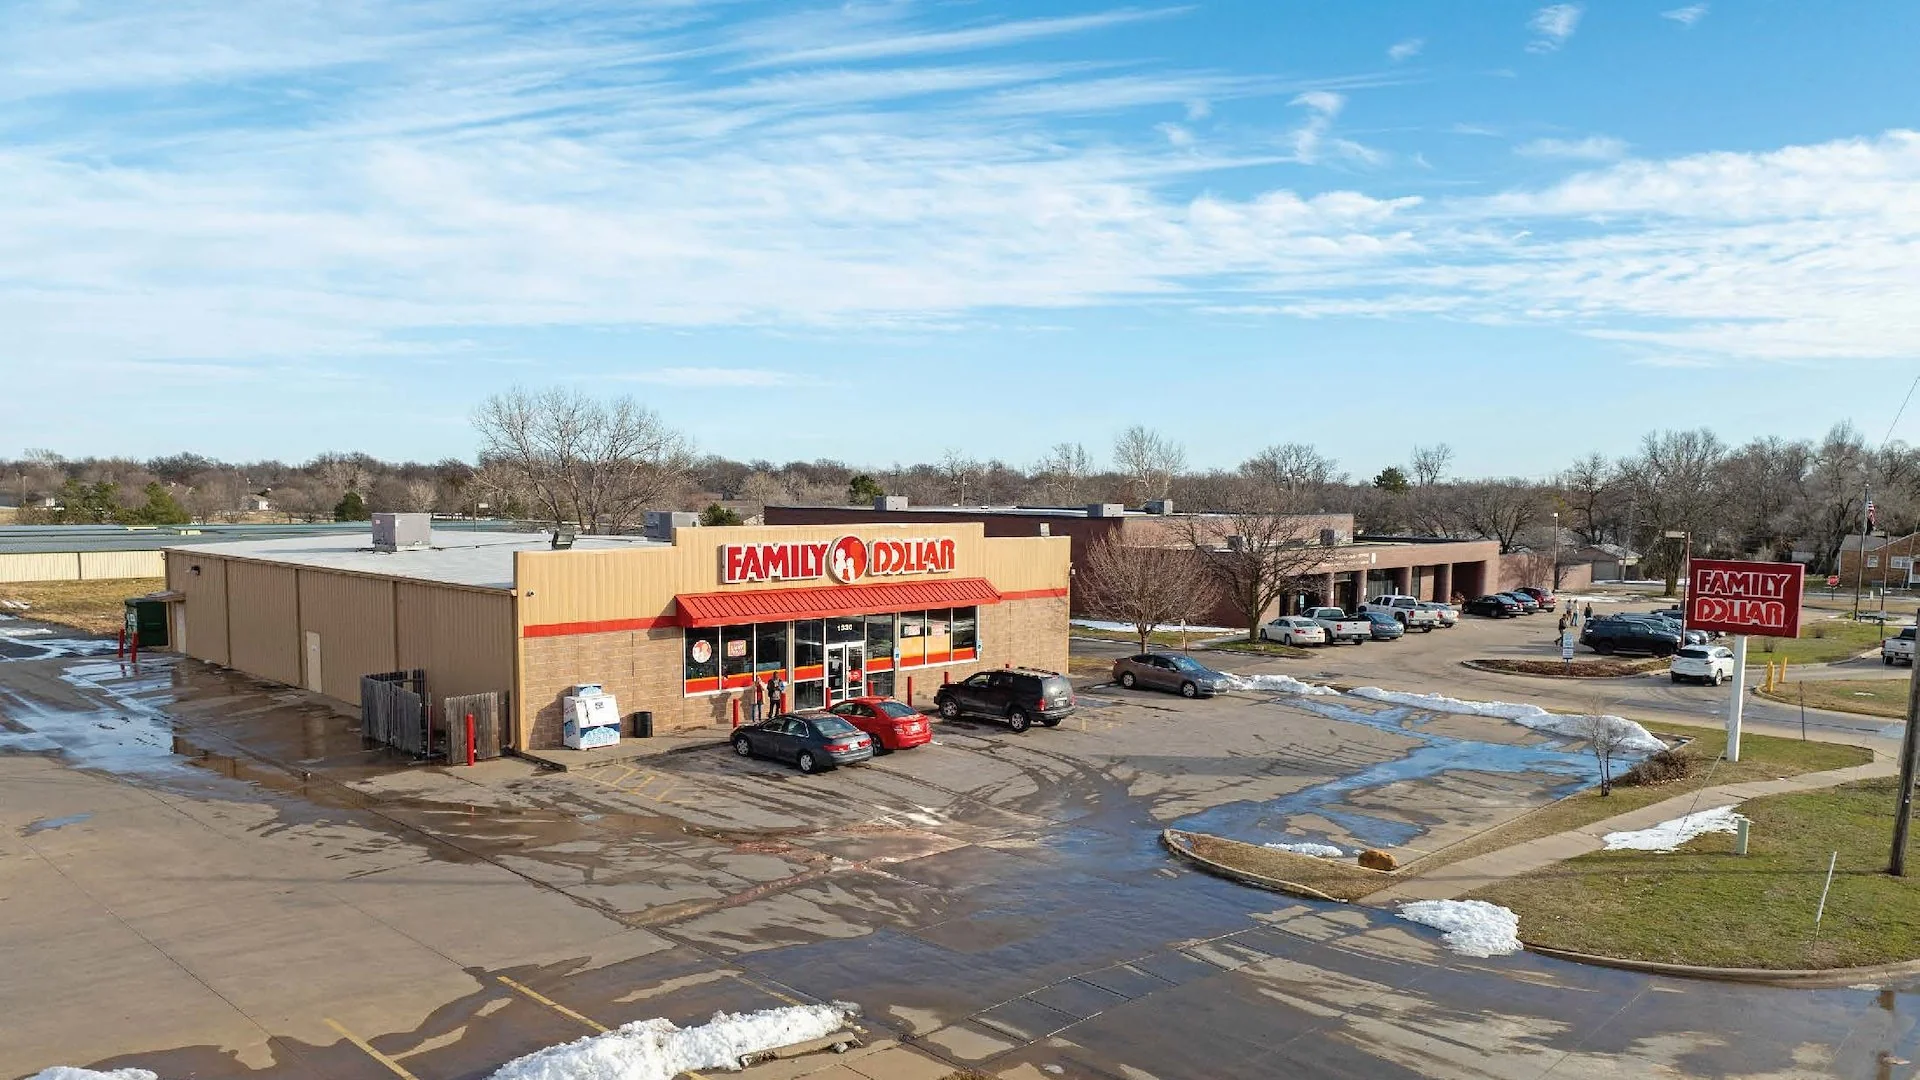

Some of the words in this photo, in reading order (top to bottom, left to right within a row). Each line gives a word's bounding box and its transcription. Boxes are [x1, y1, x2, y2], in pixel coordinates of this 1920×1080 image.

[727, 542, 829, 582] FAMILY
[872, 538, 955, 574] DOLLAR
[1697, 569, 1791, 599] FAMILY
[1695, 596, 1785, 628] DOLLAR
